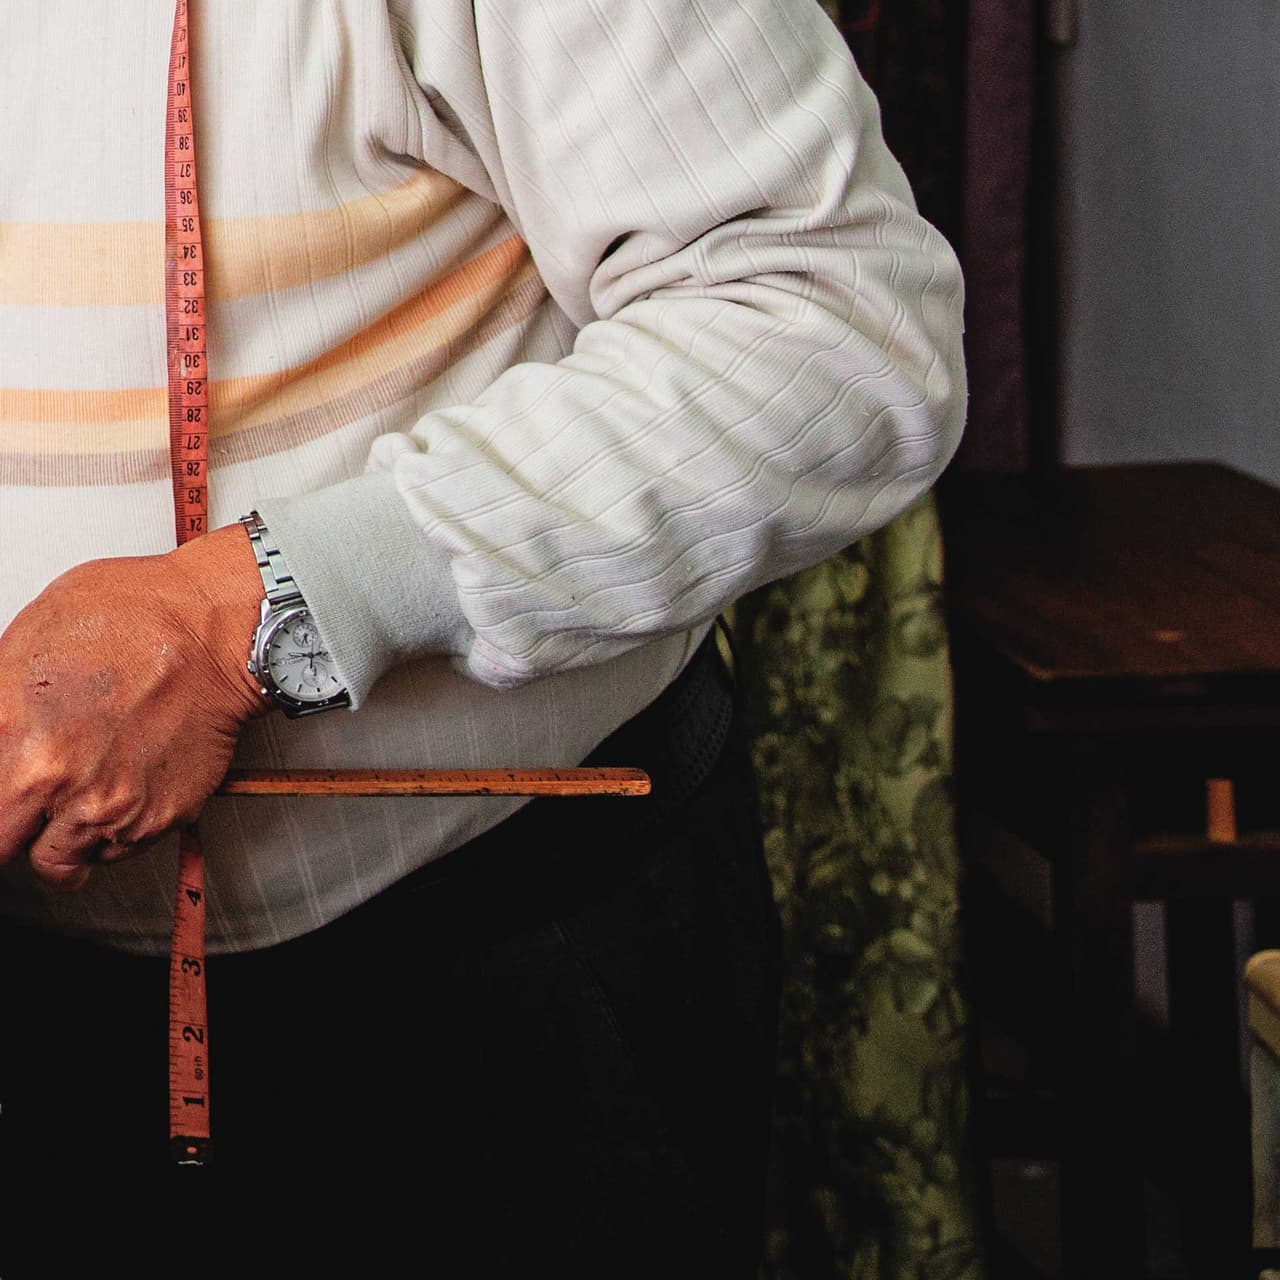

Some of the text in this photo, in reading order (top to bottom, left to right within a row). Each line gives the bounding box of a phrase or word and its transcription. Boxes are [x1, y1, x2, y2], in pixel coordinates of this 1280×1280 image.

[176, 82, 186, 96] 40
[178, 109, 188, 123] 39
[179, 136, 190, 150] 38
[180, 163, 191, 177] 37
[180, 191, 193, 205] 36
[182, 218, 195, 232] 35
[183, 245, 197, 259] 34
[183, 272, 197, 286] 33
[184, 299, 199, 314] 32
[185, 327, 199, 341] 31
[186, 381, 202, 395] 29
[186, 408, 202, 423] 28
[186, 435, 201, 450] 27
[186, 462, 201, 477] 26
[188, 489, 202, 504] 25
[190, 517, 202, 532] 24
[181, 889, 205, 1108] 4 3 2 1
